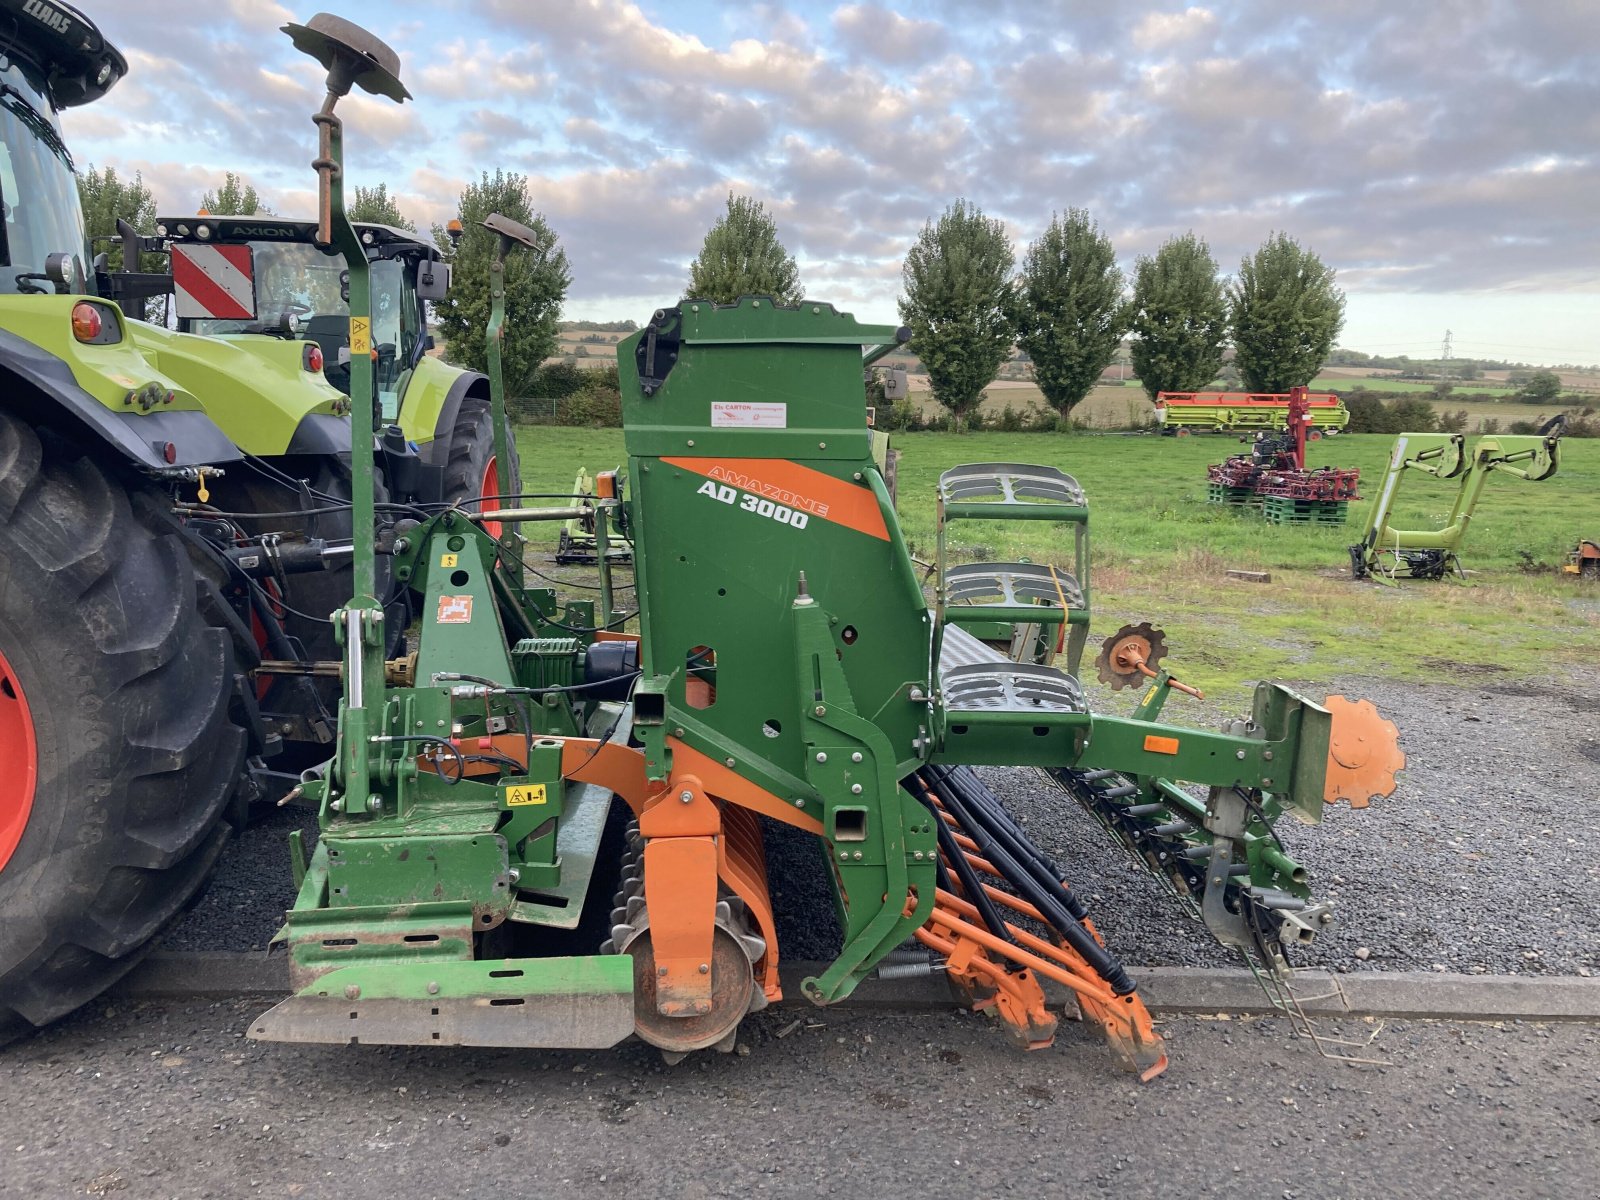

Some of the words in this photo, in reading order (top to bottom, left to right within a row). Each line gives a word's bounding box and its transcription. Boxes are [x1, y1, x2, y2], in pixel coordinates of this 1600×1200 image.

[22, 0, 71, 34] CLAAS
[232, 227, 294, 237] AXION
[696, 480, 737, 505] AD
[740, 494, 809, 530] 3000
[707, 465, 829, 518] AMAZONE
